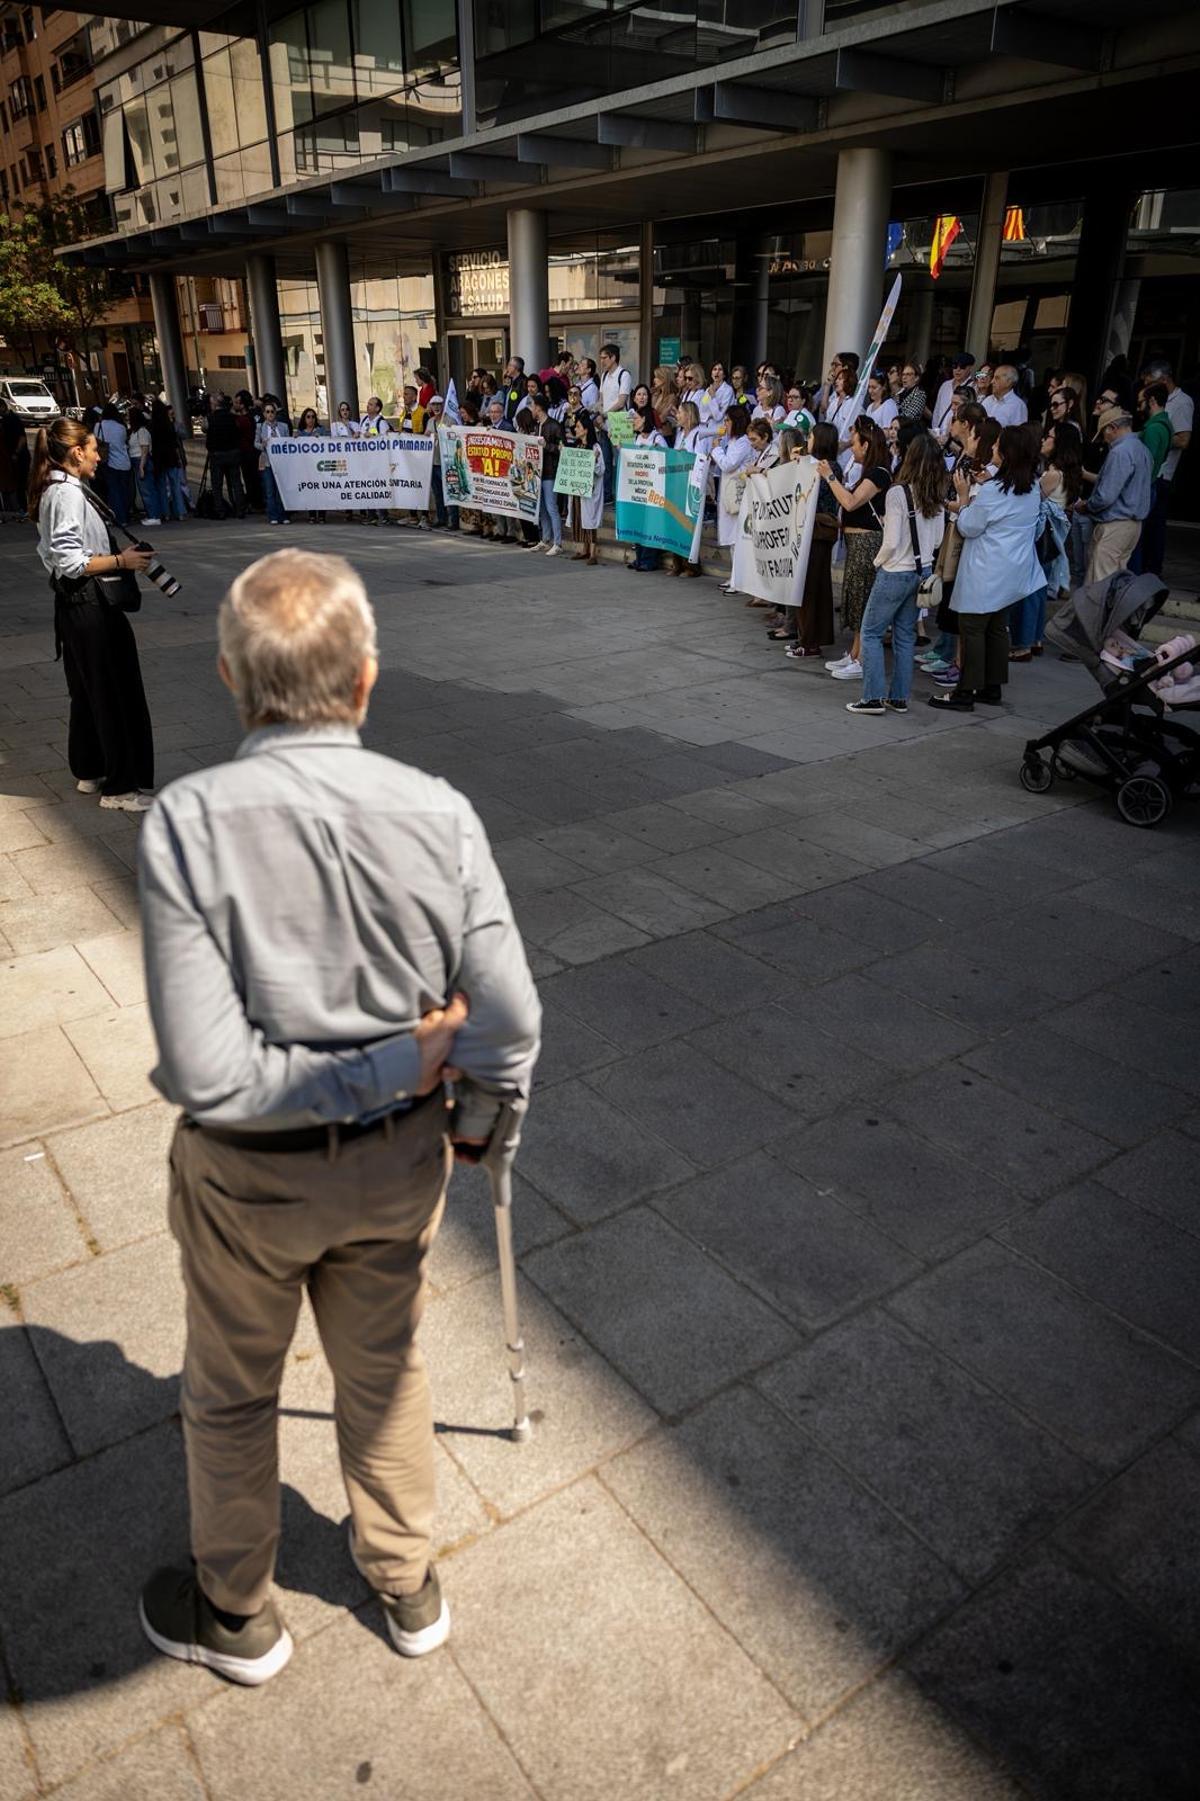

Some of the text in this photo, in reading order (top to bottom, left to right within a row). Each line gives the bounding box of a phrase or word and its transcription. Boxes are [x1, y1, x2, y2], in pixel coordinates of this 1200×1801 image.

[449, 251, 500, 272] SERVICIO
[451, 272, 509, 292] ARAGONES
[468, 294, 503, 312] SALUD
[271, 441, 325, 454] MÉDICOS
[328, 442, 342, 452] DE
[392, 439, 433, 452] PRIMARIA
[298, 482, 320, 492] ¡POR
[344, 478, 386, 489] ATENCIÓN
[388, 478, 422, 489] SNITARIA
[341, 492, 352, 500] DE
